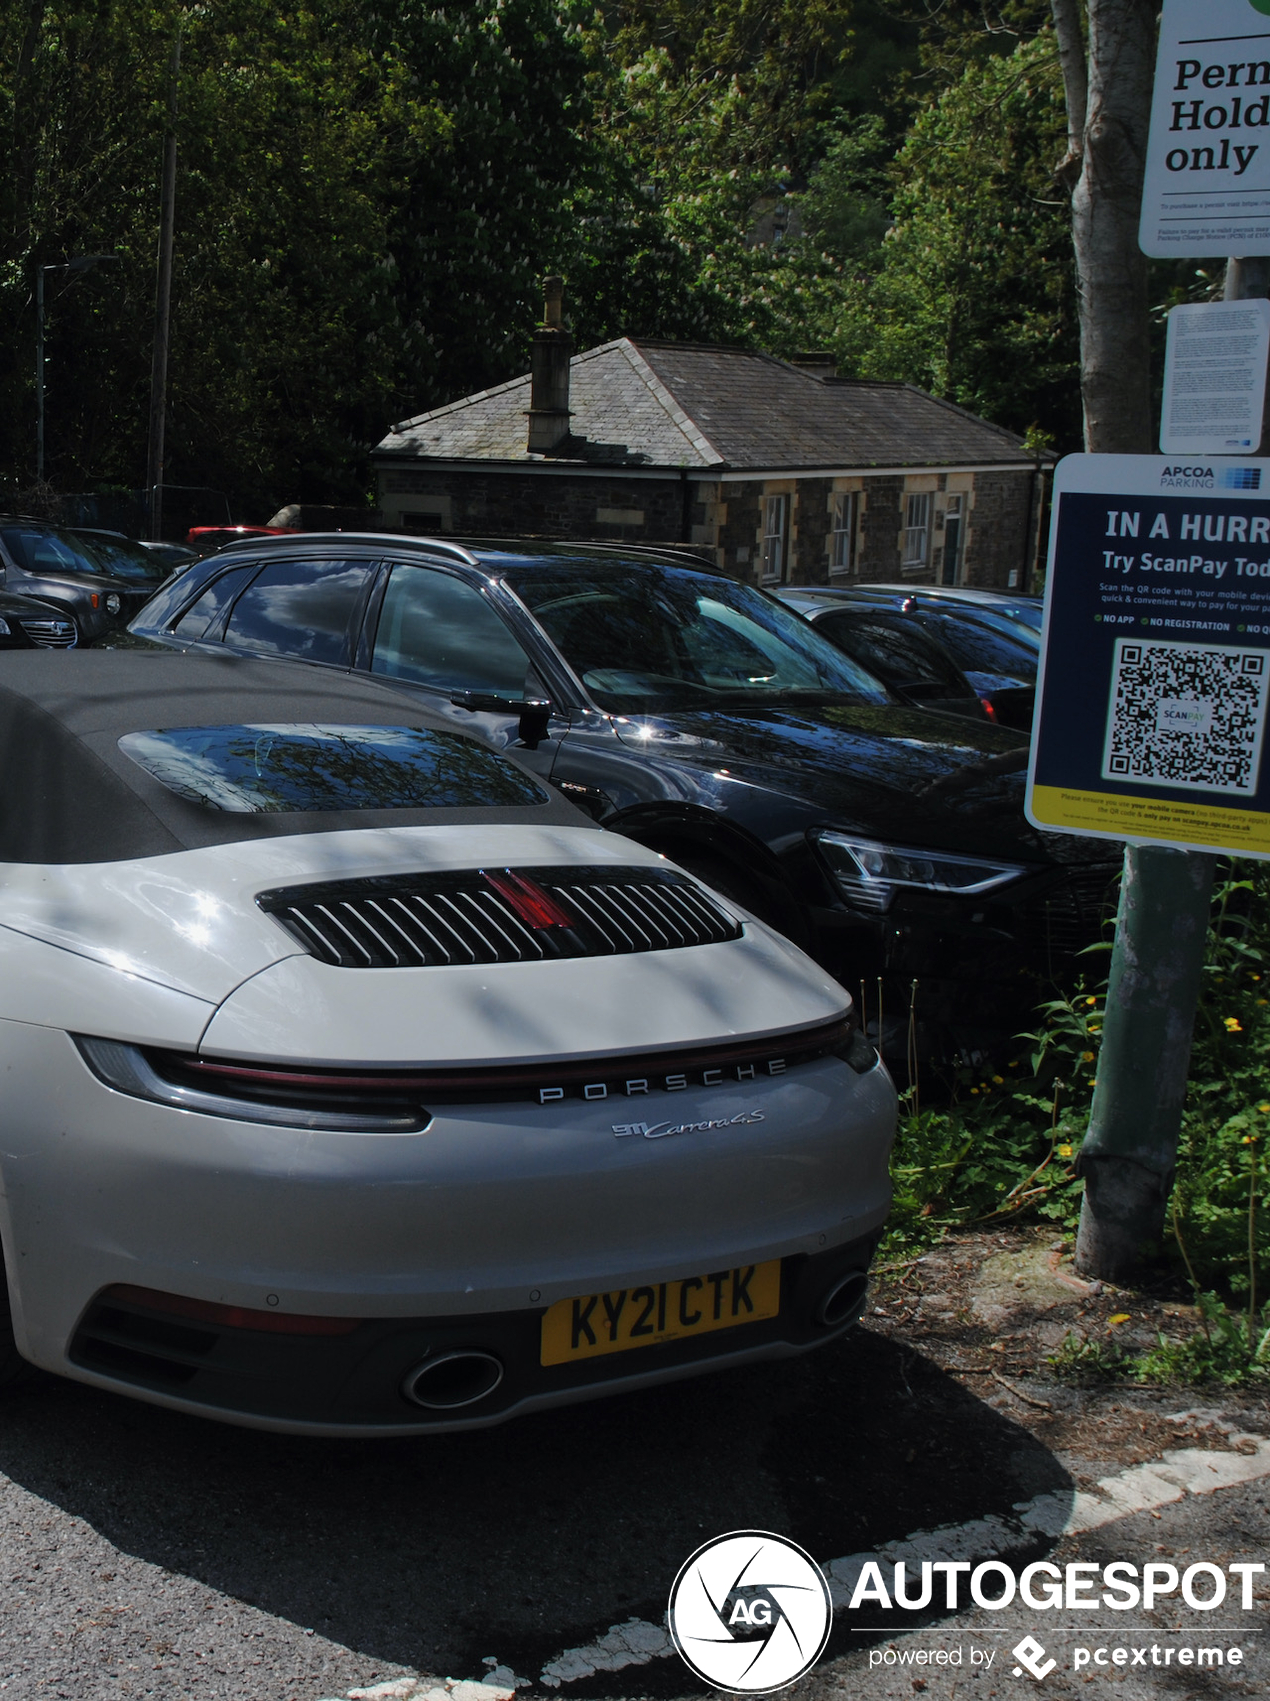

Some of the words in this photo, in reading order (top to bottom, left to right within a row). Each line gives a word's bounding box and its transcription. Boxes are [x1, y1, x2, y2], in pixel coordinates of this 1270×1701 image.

[1169, 95, 1270, 131] Hold
[1165, 139, 1259, 176] only
[1161, 466, 1214, 478] APCOA
[1160, 478, 1214, 489] PARKING
[1105, 510, 1140, 538] IN
[1148, 513, 1170, 539] A
[1180, 514, 1270, 544] HURR
[1102, 550, 1134, 574] Try
[1140, 552, 1228, 579] ScanPay
[1234, 558, 1270, 578] Tod
[1099, 582, 1118, 592] Scan
[1120, 582, 1134, 592] the
[1136, 584, 1149, 594] QR
[1152, 586, 1171, 595] code
[1174, 587, 1192, 596] with
[1196, 590, 1214, 599] your
[1218, 590, 1247, 600] mobile
[1250, 592, 1270, 600] devi
[1101, 594, 1123, 602] quick
[1125, 596, 1131, 604] &
[1133, 596, 1178, 606] convenient
[1180, 599, 1196, 609] way
[1198, 600, 1207, 608] to
[1208, 602, 1224, 611] pay
[1226, 601, 1238, 610] for
[1240, 604, 1260, 613] your
[1103, 614, 1116, 624] NO
[1117, 615, 1135, 624] APP
[1150, 618, 1163, 626] NO
[1164, 618, 1230, 632] REGISTRATION
[1246, 624, 1260, 634] NO
[1164, 709, 1205, 721] SCANPAY
[1061, 793, 1082, 802] Please
[1148, 804, 1170, 812] mobile
[1171, 808, 1195, 816] camera
[1144, 812, 1158, 820] only
[539, 1058, 787, 1104] PORSCHE
[644, 1118, 730, 1138] Carrera
[572, 1283, 667, 1348] KY21
[679, 1265, 755, 1326] CTK
